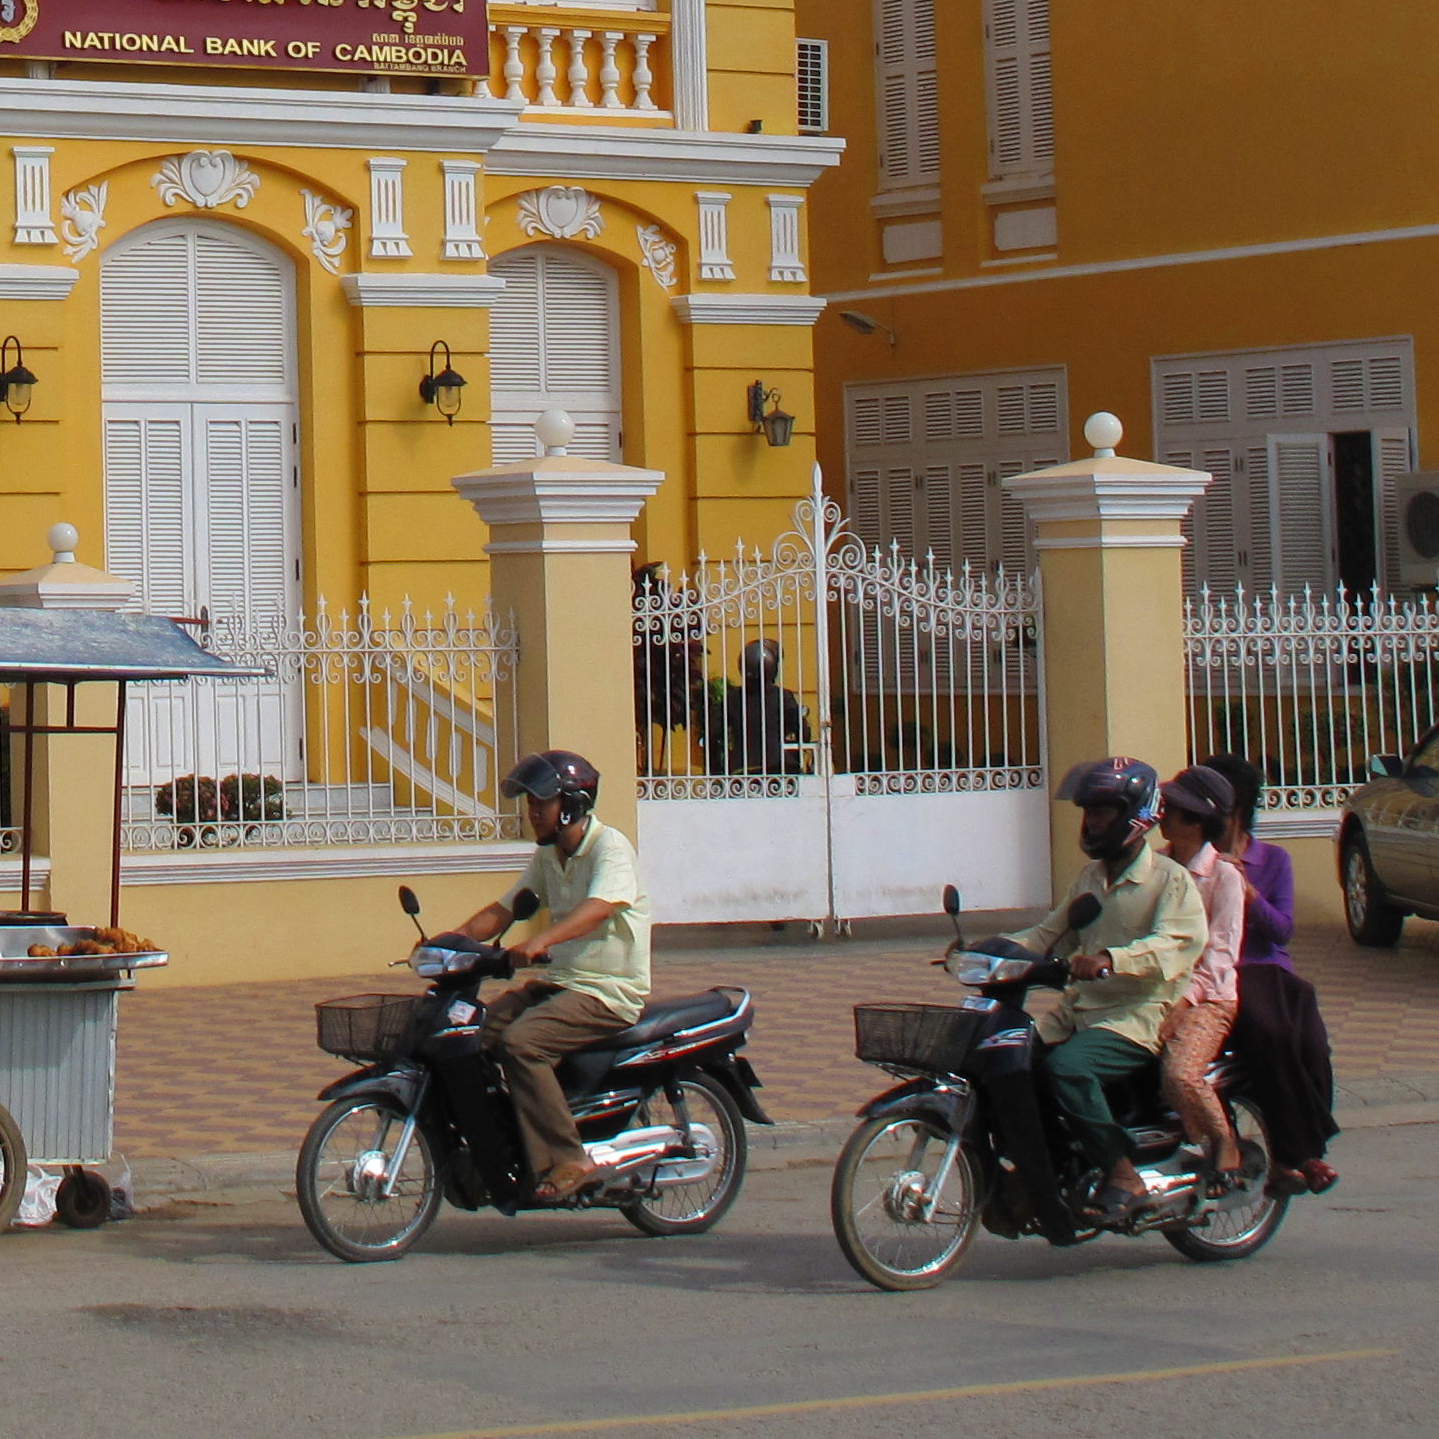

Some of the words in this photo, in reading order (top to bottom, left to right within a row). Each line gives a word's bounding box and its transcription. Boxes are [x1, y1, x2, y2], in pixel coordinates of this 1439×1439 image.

[63, 30, 195, 54] NATIONAL
[205, 36, 278, 58] BANK
[287, 40, 321, 59] OF
[334, 44, 469, 67] CAMBODIA
[431, 64, 467, 74] BRANCH
